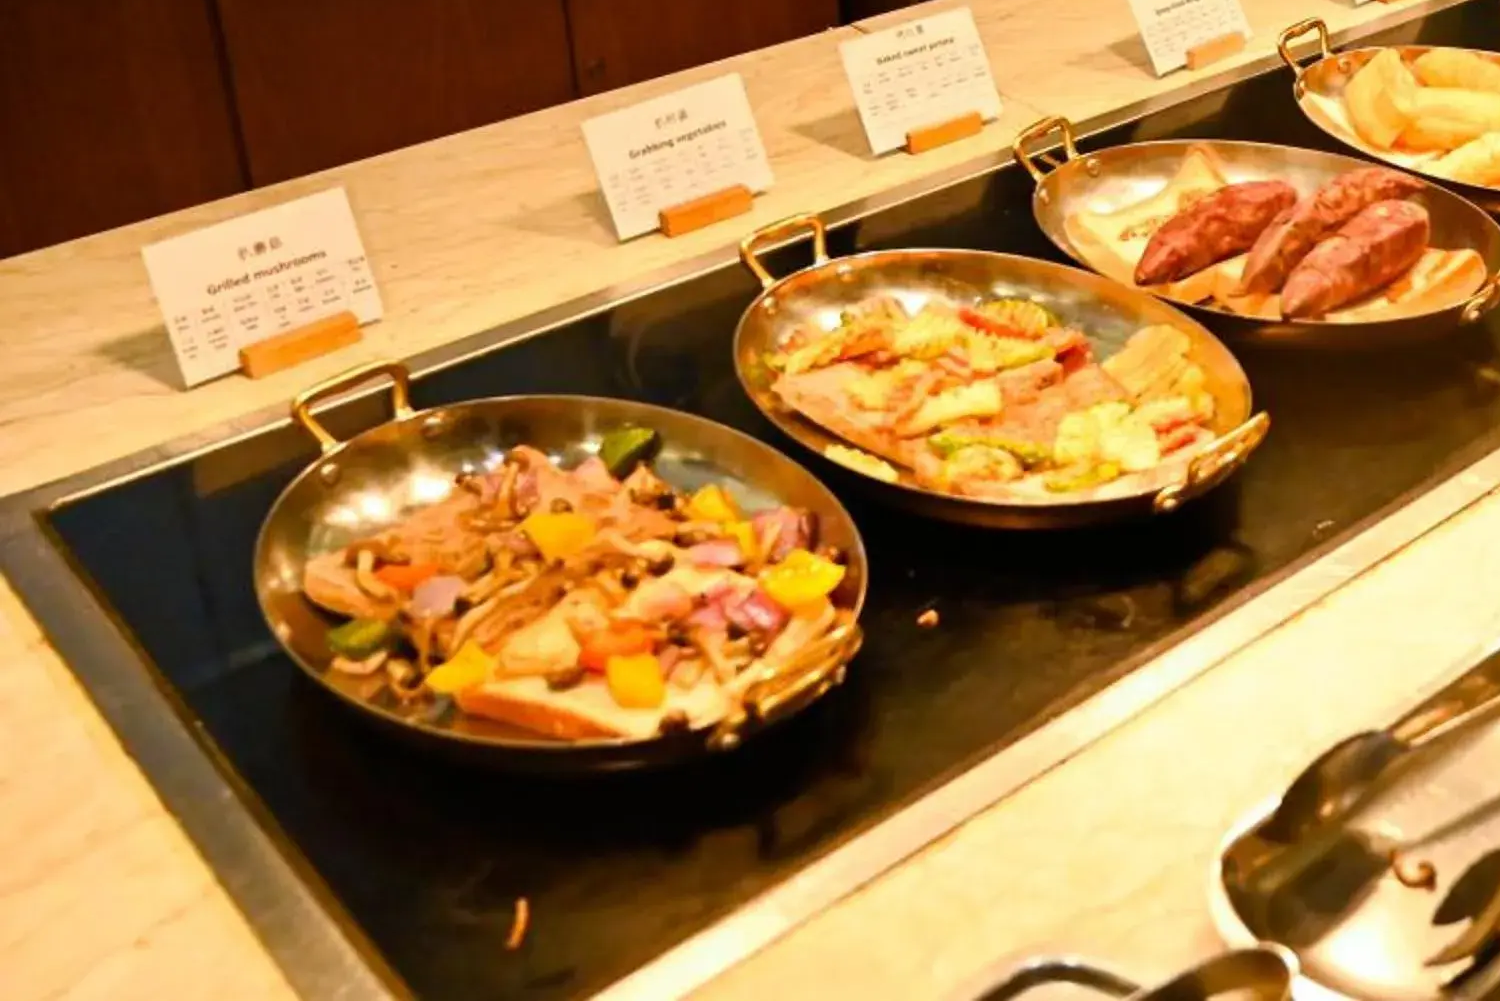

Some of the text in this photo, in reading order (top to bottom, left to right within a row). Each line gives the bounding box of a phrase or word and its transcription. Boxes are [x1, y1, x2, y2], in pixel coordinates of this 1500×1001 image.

[676, 119, 727, 144] vegetables
[206, 273, 251, 297] Grilled
[253, 249, 328, 280] mushrooms
